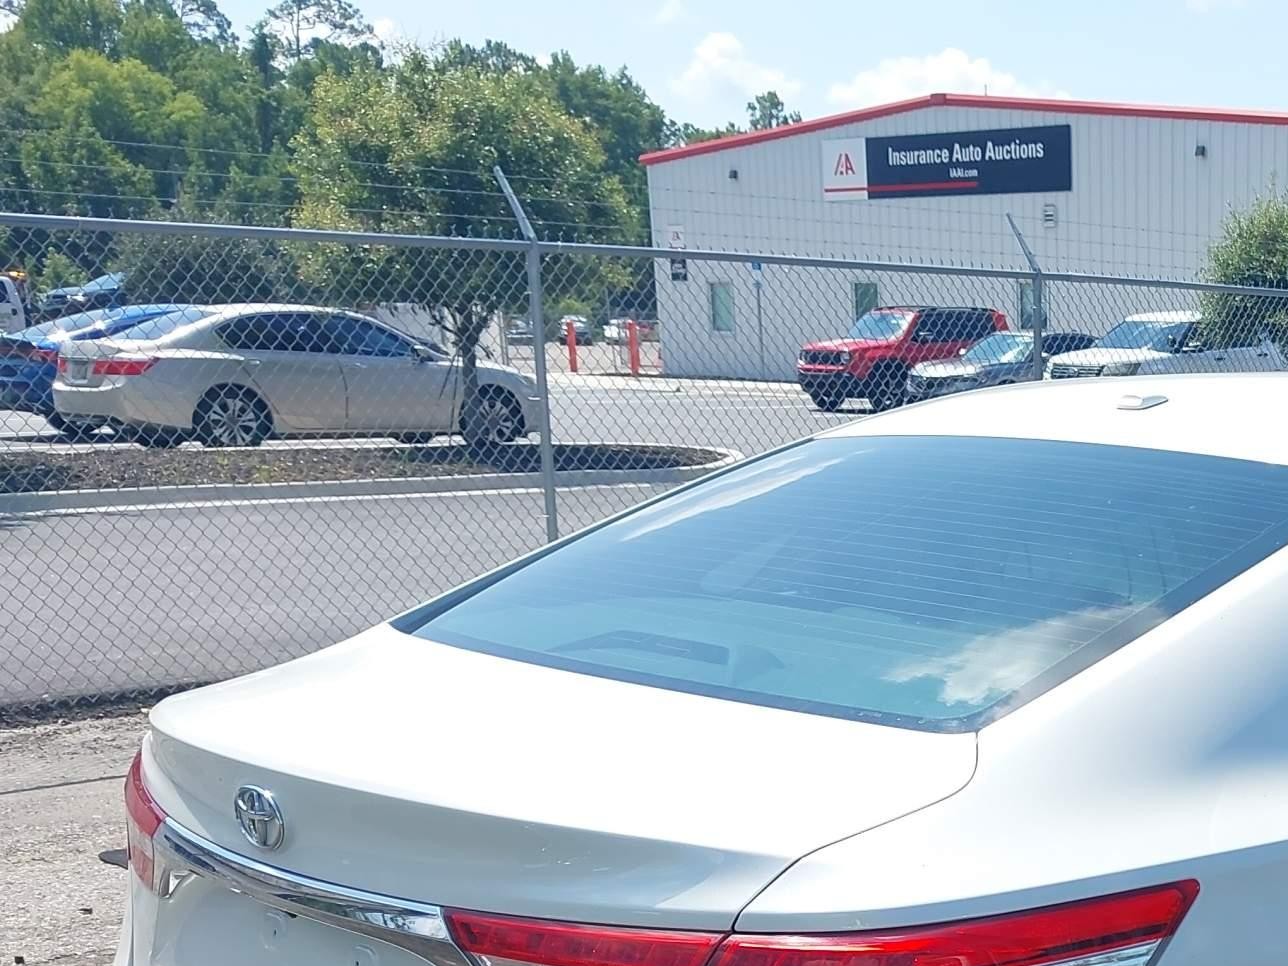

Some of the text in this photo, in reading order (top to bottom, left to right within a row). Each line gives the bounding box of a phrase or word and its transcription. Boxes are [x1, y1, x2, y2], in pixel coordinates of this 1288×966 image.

[888, 139, 1044, 166] Insurance Auto Auctions
